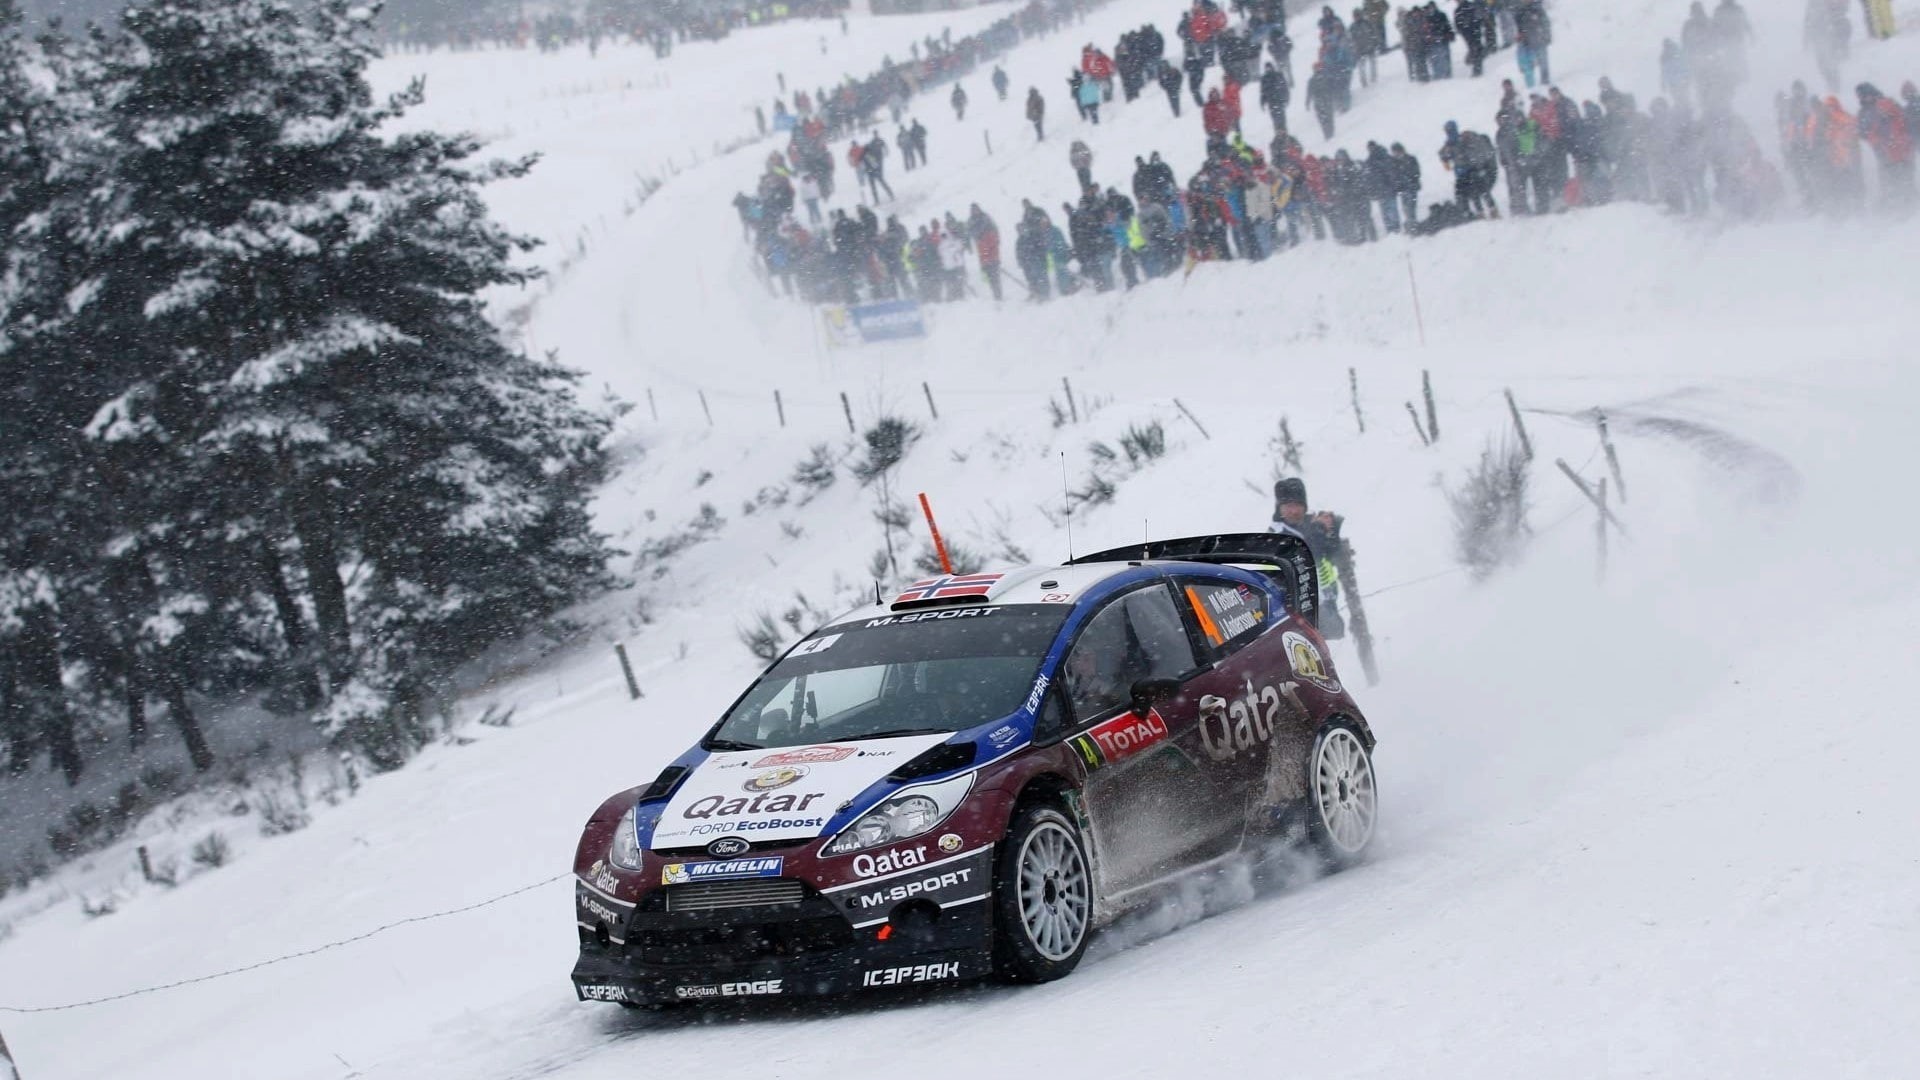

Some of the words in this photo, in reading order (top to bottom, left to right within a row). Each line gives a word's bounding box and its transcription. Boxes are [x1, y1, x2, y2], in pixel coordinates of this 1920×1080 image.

[865, 607, 1000, 628] M-SPORT
[804, 638, 825, 653] 4
[1199, 679, 1309, 761] Qatar
[1077, 736, 1099, 768] 4
[683, 792, 825, 820] Qatar
[689, 821, 735, 836] FORD
[736, 816, 824, 832] EcoBoost
[715, 841, 739, 854] Ford
[832, 842, 861, 853] PIAA
[691, 858, 780, 876] MICHELIN
[853, 846, 928, 878] Qatar
[595, 865, 620, 896] Qatar
[861, 868, 972, 909] M-SPORT
[687, 985, 719, 997] Castrol
[721, 979, 783, 997] EDGE
